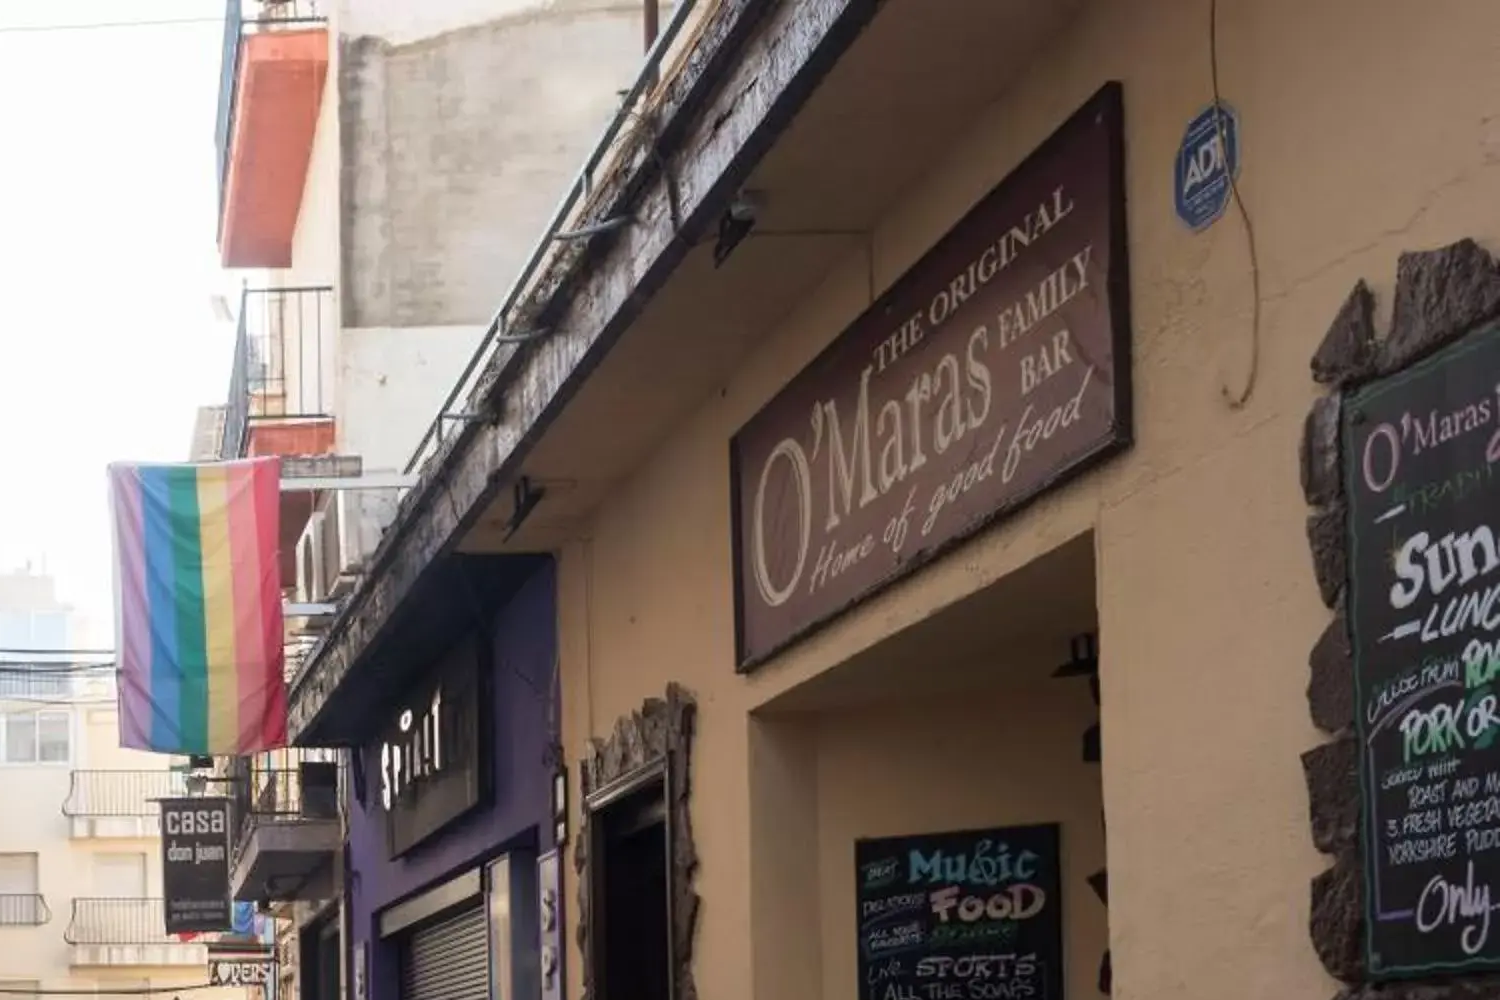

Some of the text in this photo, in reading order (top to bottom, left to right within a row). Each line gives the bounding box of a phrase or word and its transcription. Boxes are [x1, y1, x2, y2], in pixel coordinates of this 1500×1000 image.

[1184, 133, 1222, 192] ADT
[873, 187, 1073, 375] THE ORIGINAL
[1000, 246, 1092, 348] FAMILY
[1019, 330, 1072, 395] BAR
[753, 325, 993, 607] O'Maras
[1363, 396, 1491, 492] O'Maras
[809, 364, 1094, 594] Home of good food
[1399, 694, 1500, 764] PORK OR
[166, 809, 225, 835] casa
[1403, 807, 1441, 833] FRESH
[1407, 779, 1448, 809] ROAST
[1452, 776, 1479, 801] AND
[167, 839, 224, 865] don juan
[930, 883, 1045, 922] FOOD
[1417, 859, 1490, 955] Only
[916, 953, 1037, 977] SPORTS
[921, 982, 964, 1000] THE
